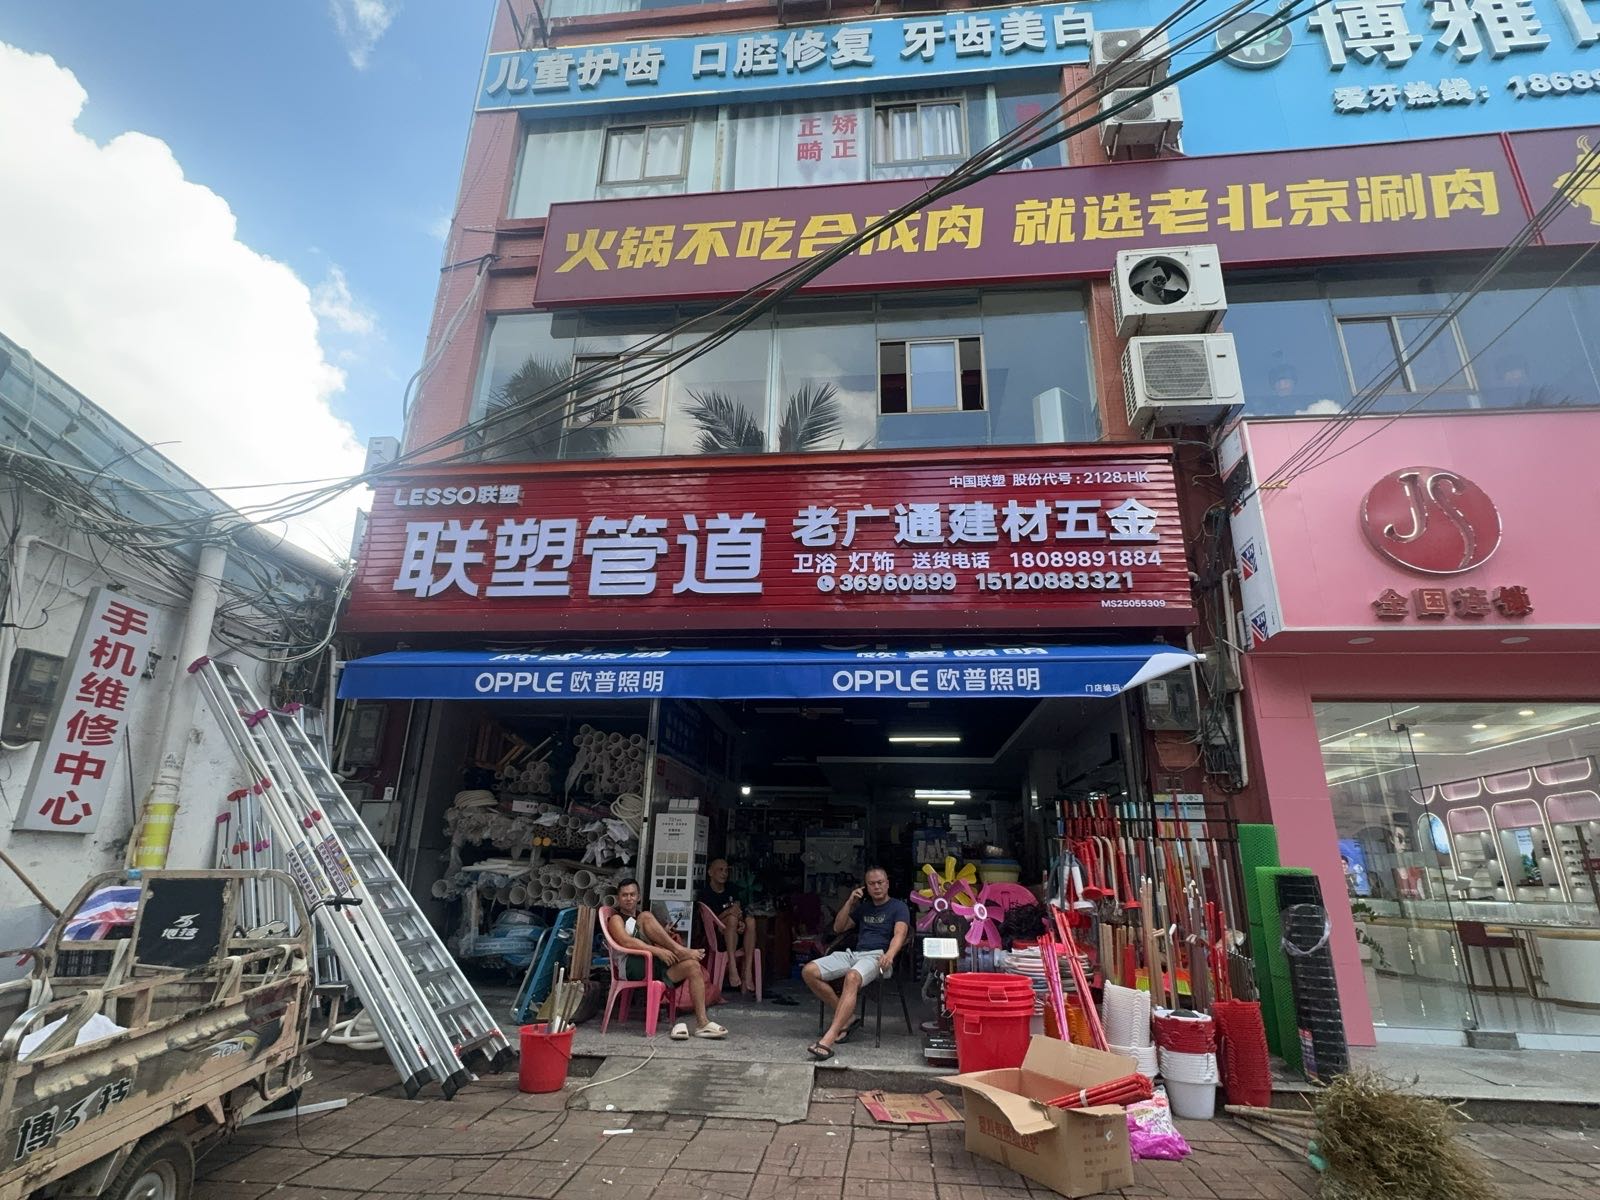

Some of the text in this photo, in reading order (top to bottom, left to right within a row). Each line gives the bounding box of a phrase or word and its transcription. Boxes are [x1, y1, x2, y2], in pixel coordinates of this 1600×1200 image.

[487, 7, 1095, 96] 儿童护齿 口腔修复 牙齿美白
[555, 168, 1500, 275] 火锅不吃合成肉 就选老北京涮肉
[950, 474, 1006, 488] 中国联塑
[791, 497, 1161, 547] 老广通建材五金
[392, 511, 767, 598] 联塑管道
[792, 550, 1162, 574] 卫浴 灯饰 送货电话 18089891884
[839, 571, 1134, 592] 36960899 15120883321
[1101, 599, 1166, 609] MS25055309
[475, 670, 664, 693] OPPLE 欧普照明
[832, 667, 1041, 692] OPPLE 欧普照明
[38, 600, 149, 826] 手机维修中心
